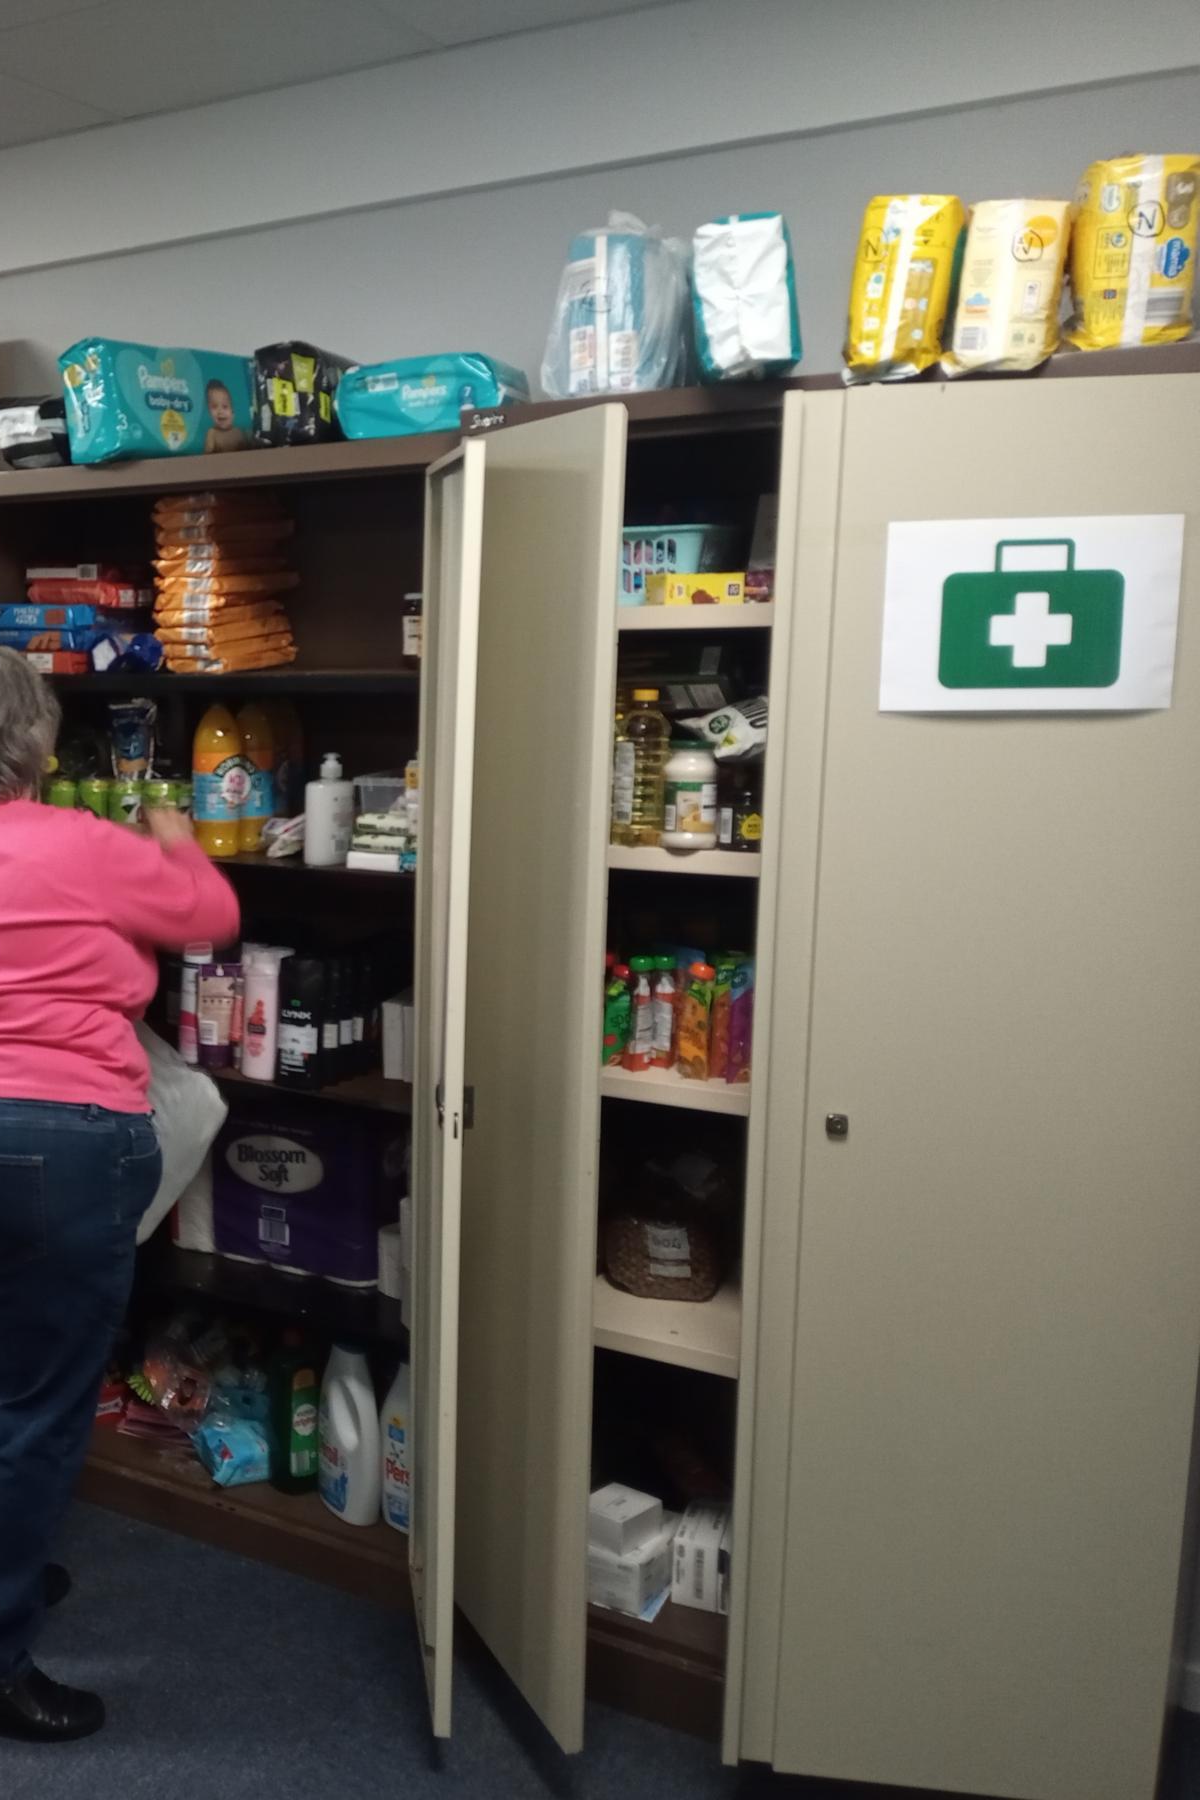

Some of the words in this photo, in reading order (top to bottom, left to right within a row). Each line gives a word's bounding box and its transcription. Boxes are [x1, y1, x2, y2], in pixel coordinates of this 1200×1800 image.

[137, 365, 189, 394] Pampers
[401, 384, 448, 400] Pampers
[148, 395, 189, 412] baby-dry
[116, 413, 128, 431] 3
[281, 1009, 312, 1020] LYNX
[237, 1144, 307, 1164] Blossom
[259, 1164, 289, 1188] Soft
